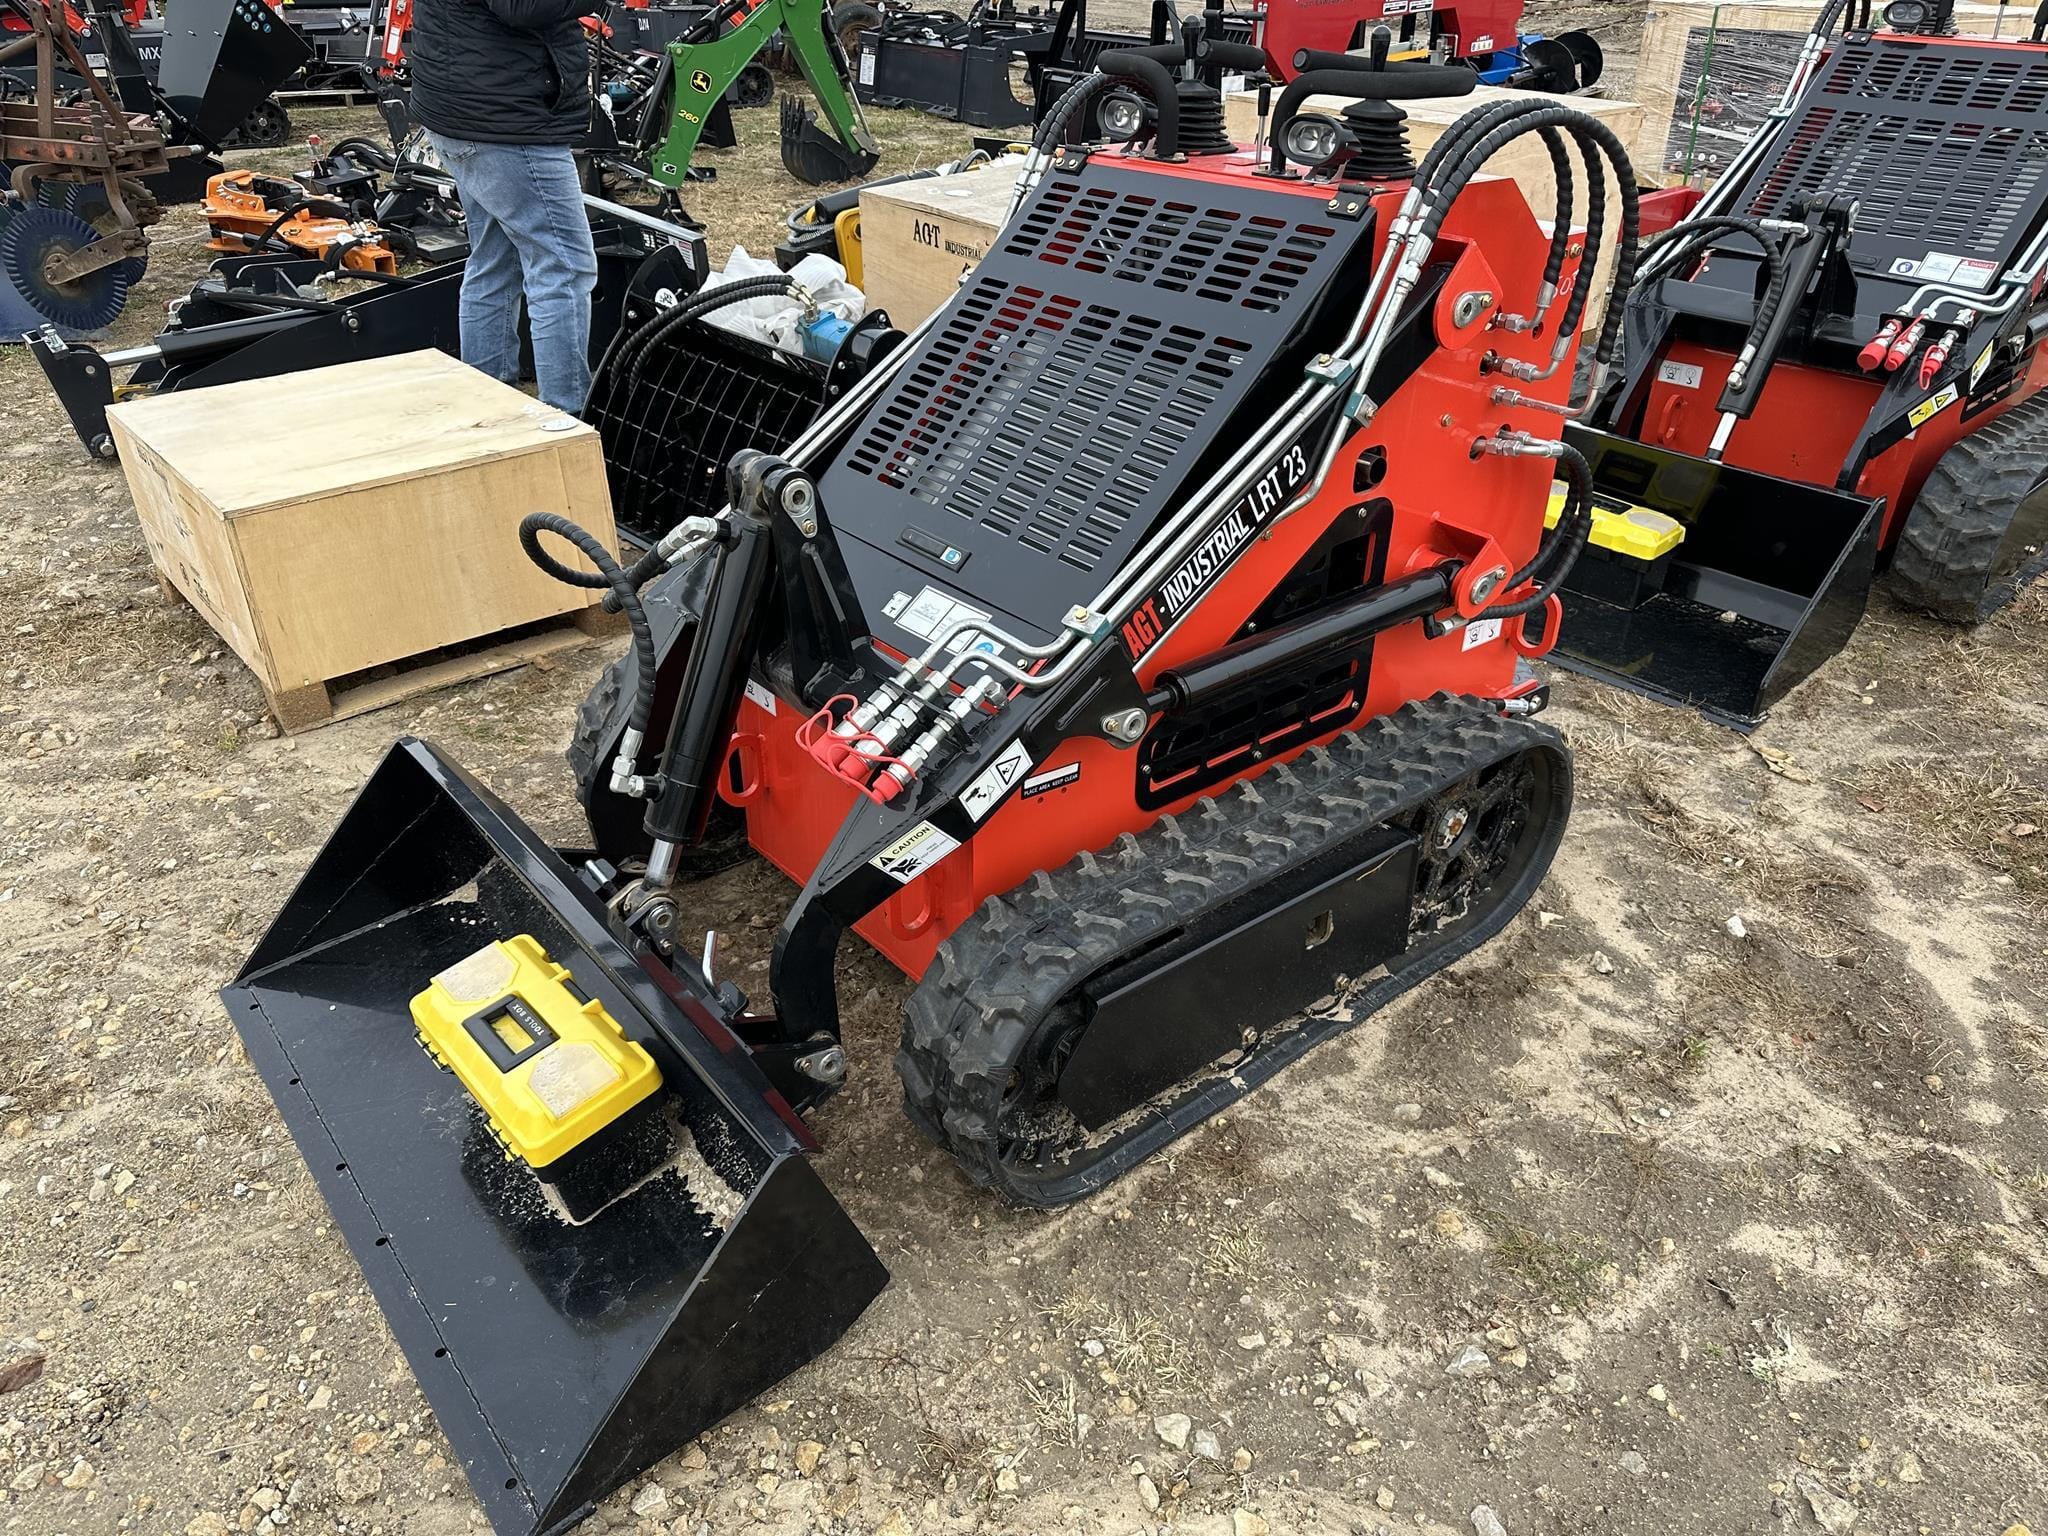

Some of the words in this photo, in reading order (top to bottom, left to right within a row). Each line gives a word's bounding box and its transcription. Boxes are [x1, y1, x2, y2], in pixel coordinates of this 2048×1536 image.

[138, 46, 162, 60] MX
[678, 109, 699, 124] 260
[912, 218, 941, 248] AGT
[944, 239, 983, 261] INDUSTRIAL
[1121, 597, 1163, 660] AGT
[1162, 511, 1250, 614] INDUSTRIAL
[1247, 466, 1284, 523] LRT
[1282, 445, 1307, 488] 23
[1023, 786, 1038, 797] PLACE
[1038, 782, 1051, 792] AREA
[1064, 773, 1079, 783] CLEAR
[892, 826, 931, 856] CAUTION
[512, 1003, 527, 1017] BOX
[524, 1016, 545, 1036] TOOLS
